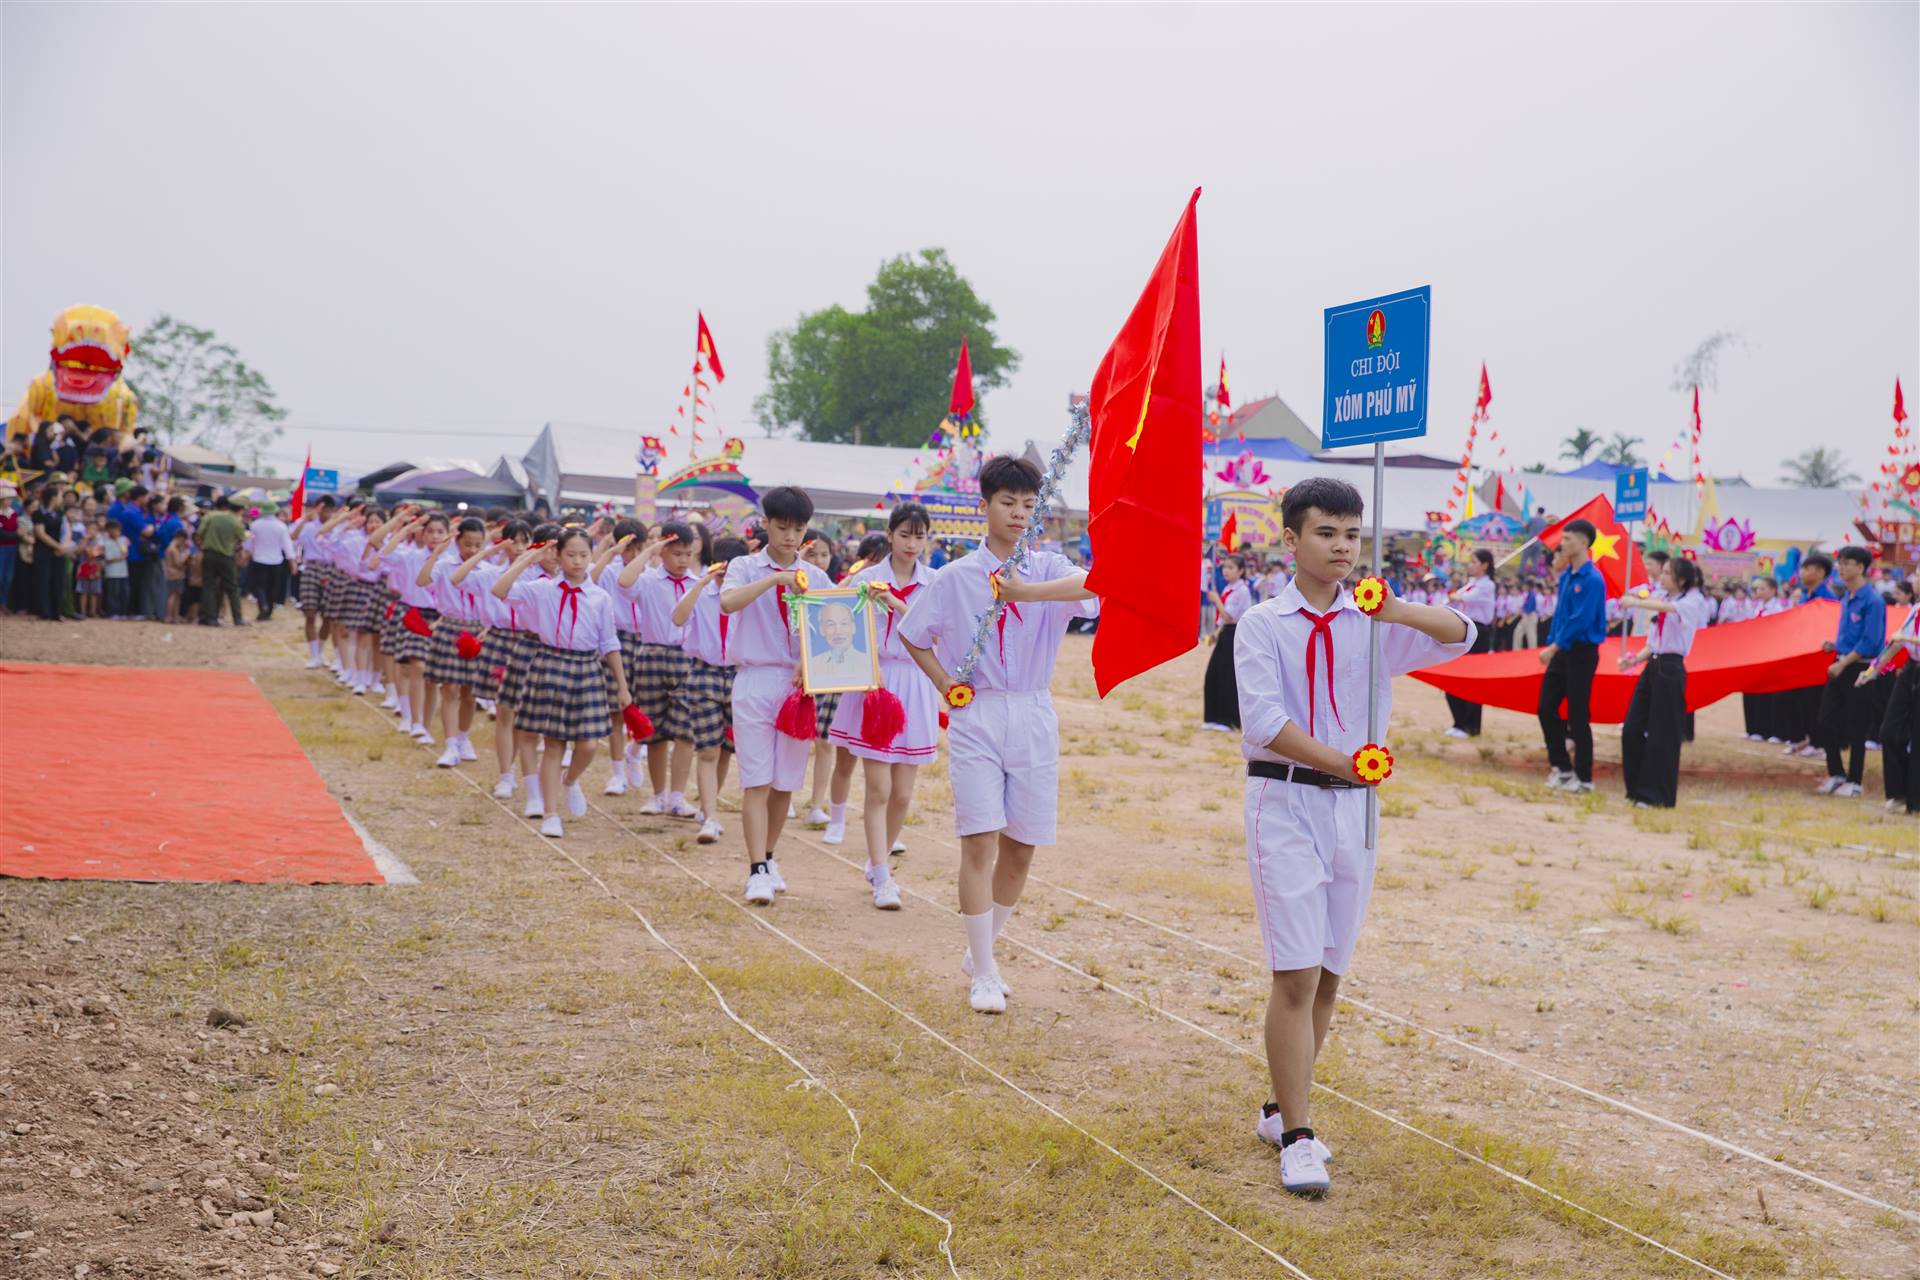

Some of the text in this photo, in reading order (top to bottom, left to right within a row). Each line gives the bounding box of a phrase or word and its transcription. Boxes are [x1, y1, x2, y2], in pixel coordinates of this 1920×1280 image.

[1351, 349, 1400, 377] CHI ĐỘI
[1334, 378, 1417, 423] XÓM PHÚ MỸ
